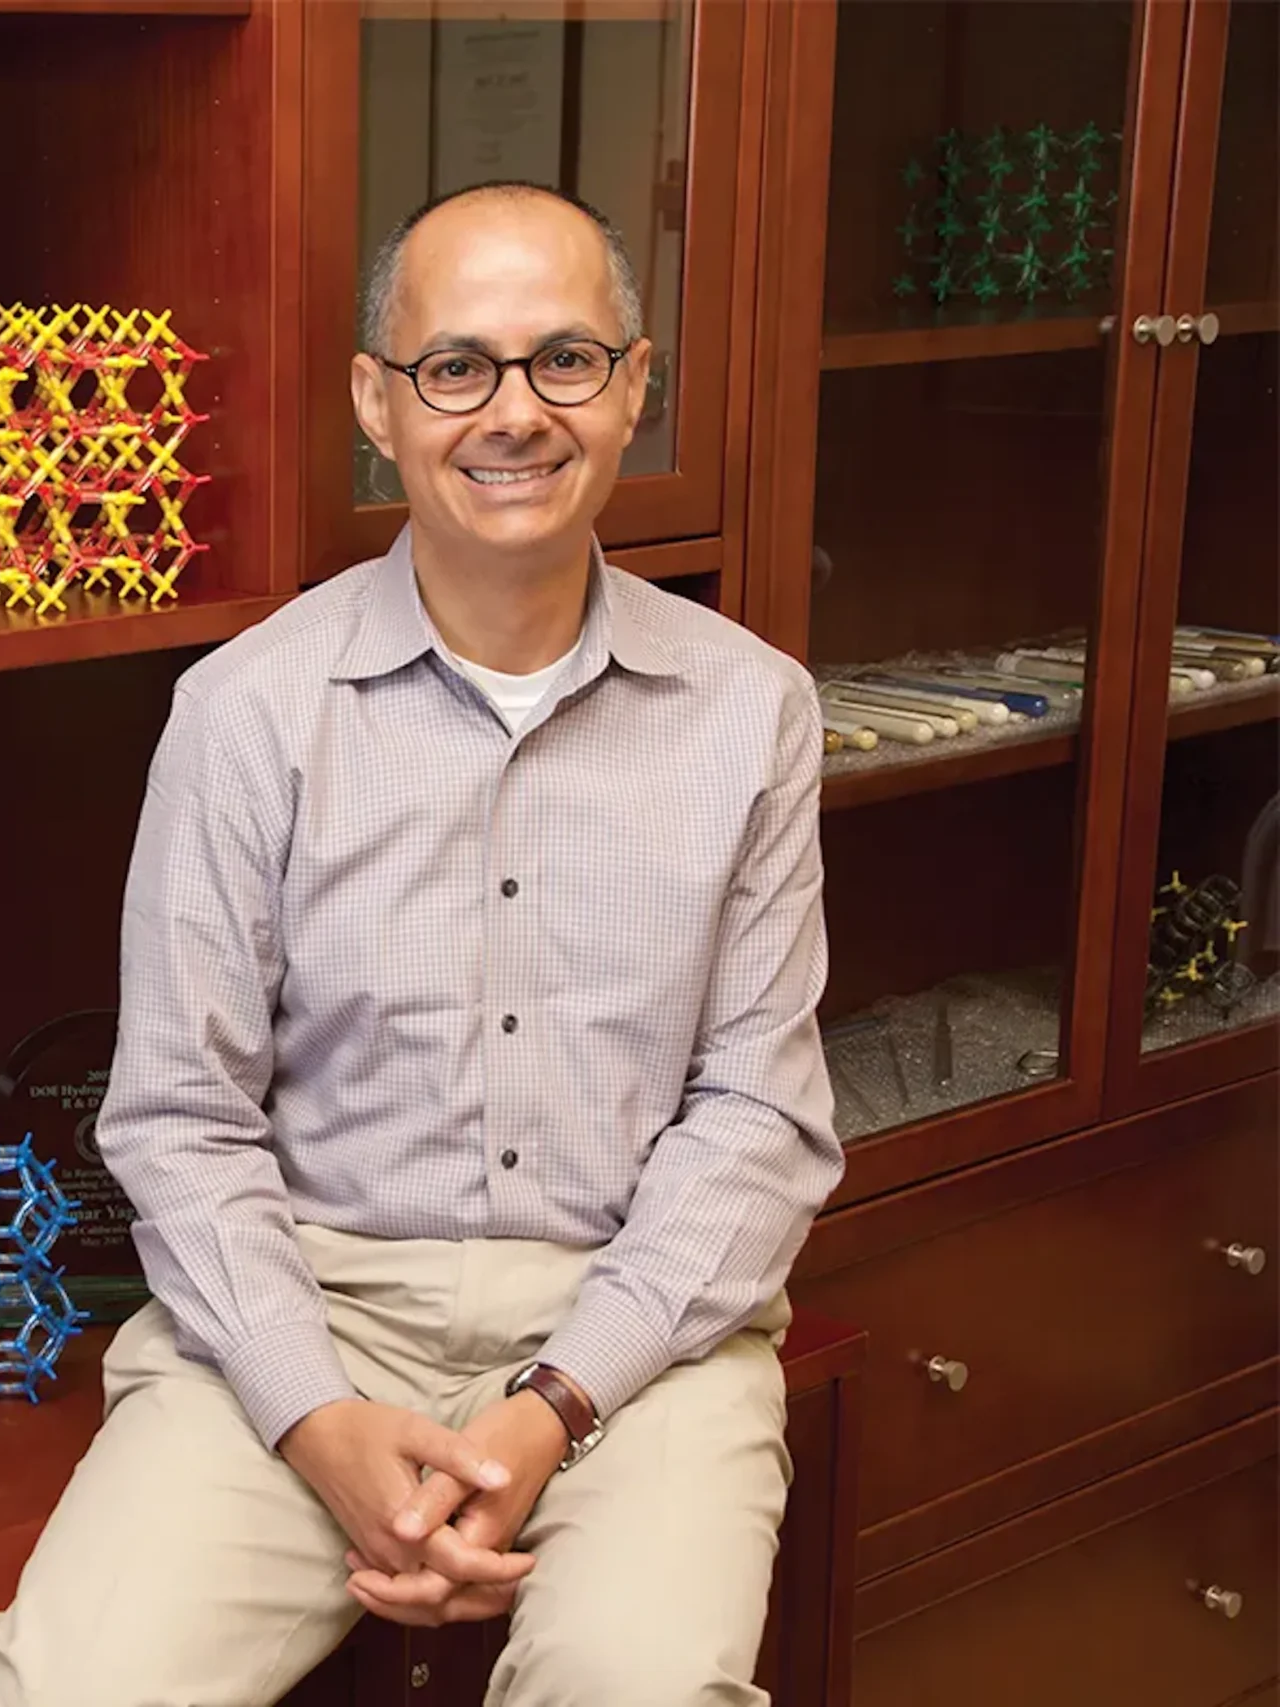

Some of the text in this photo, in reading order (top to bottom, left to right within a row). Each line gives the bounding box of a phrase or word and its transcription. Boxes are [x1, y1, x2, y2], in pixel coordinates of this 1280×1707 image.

[29, 1083, 107, 1099] DOE Hydrog
[86, 1096, 100, 1109] D
[67, 1208, 102, 1220] mar
